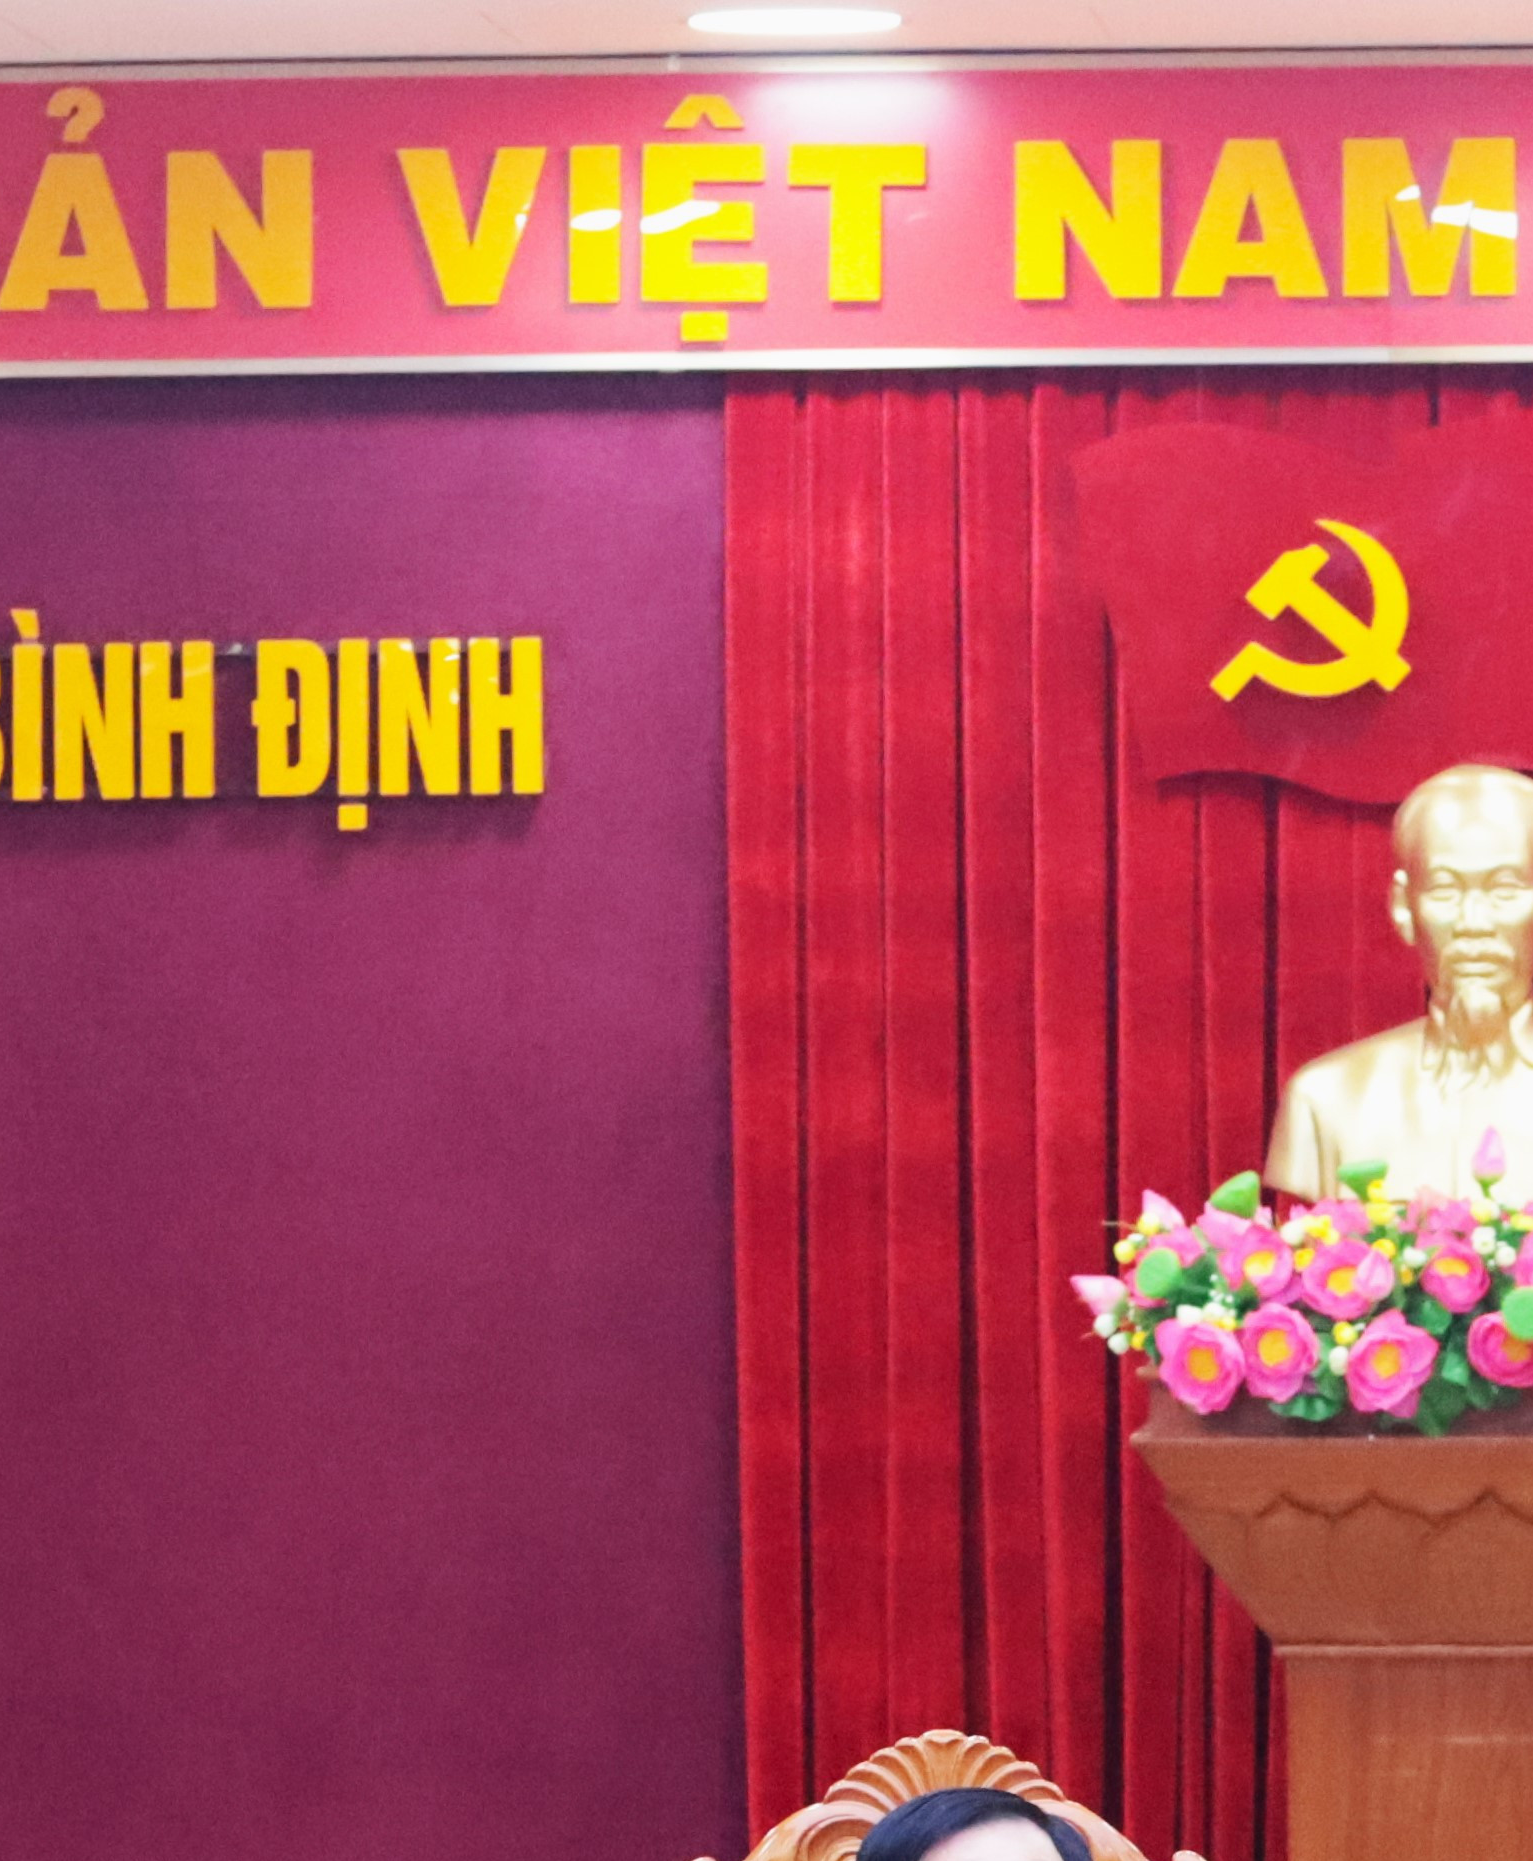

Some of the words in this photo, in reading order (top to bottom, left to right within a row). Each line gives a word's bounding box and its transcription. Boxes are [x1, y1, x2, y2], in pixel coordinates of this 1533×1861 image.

[400, 94, 927, 342] VIỆT
[1013, 137, 1518, 301] NAM
[252, 636, 545, 831] ĐỊNH
